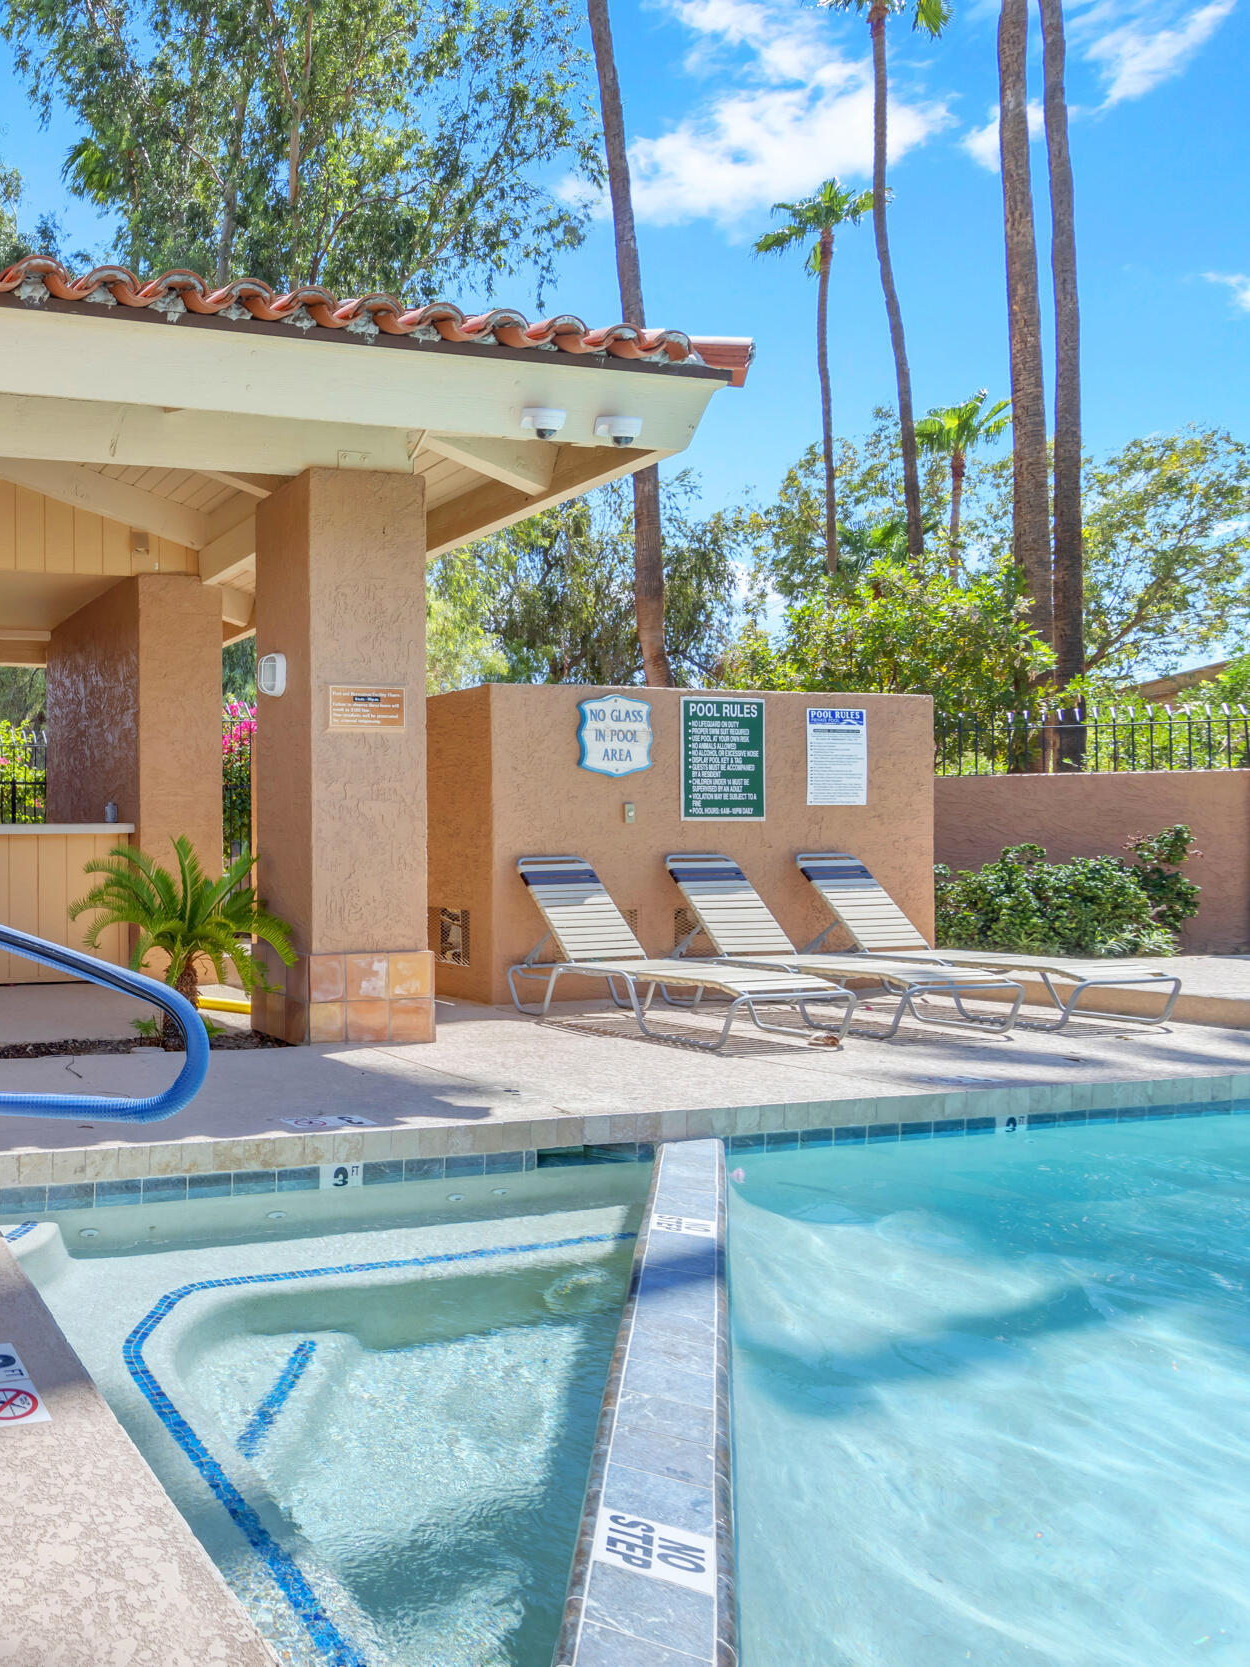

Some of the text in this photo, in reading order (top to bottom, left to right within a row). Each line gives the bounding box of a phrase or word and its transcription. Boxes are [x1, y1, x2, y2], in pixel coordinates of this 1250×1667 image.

[590, 709, 643, 722] NO GLASS
[690, 702, 758, 717] POOL RULES
[811, 710, 860, 719] POOL RULES
[595, 729, 638, 742] IN POOL
[603, 749, 632, 761] AREA
[1006, 1117, 1017, 1132] 3
[333, 1166, 359, 1187] 3 FT
[657, 1216, 683, 1231] STEP
[685, 1222, 710, 1232] NO
[4, 1368, 24, 1377] FT
[606, 1515, 655, 1569] STEP
[657, 1537, 706, 1573] NO
